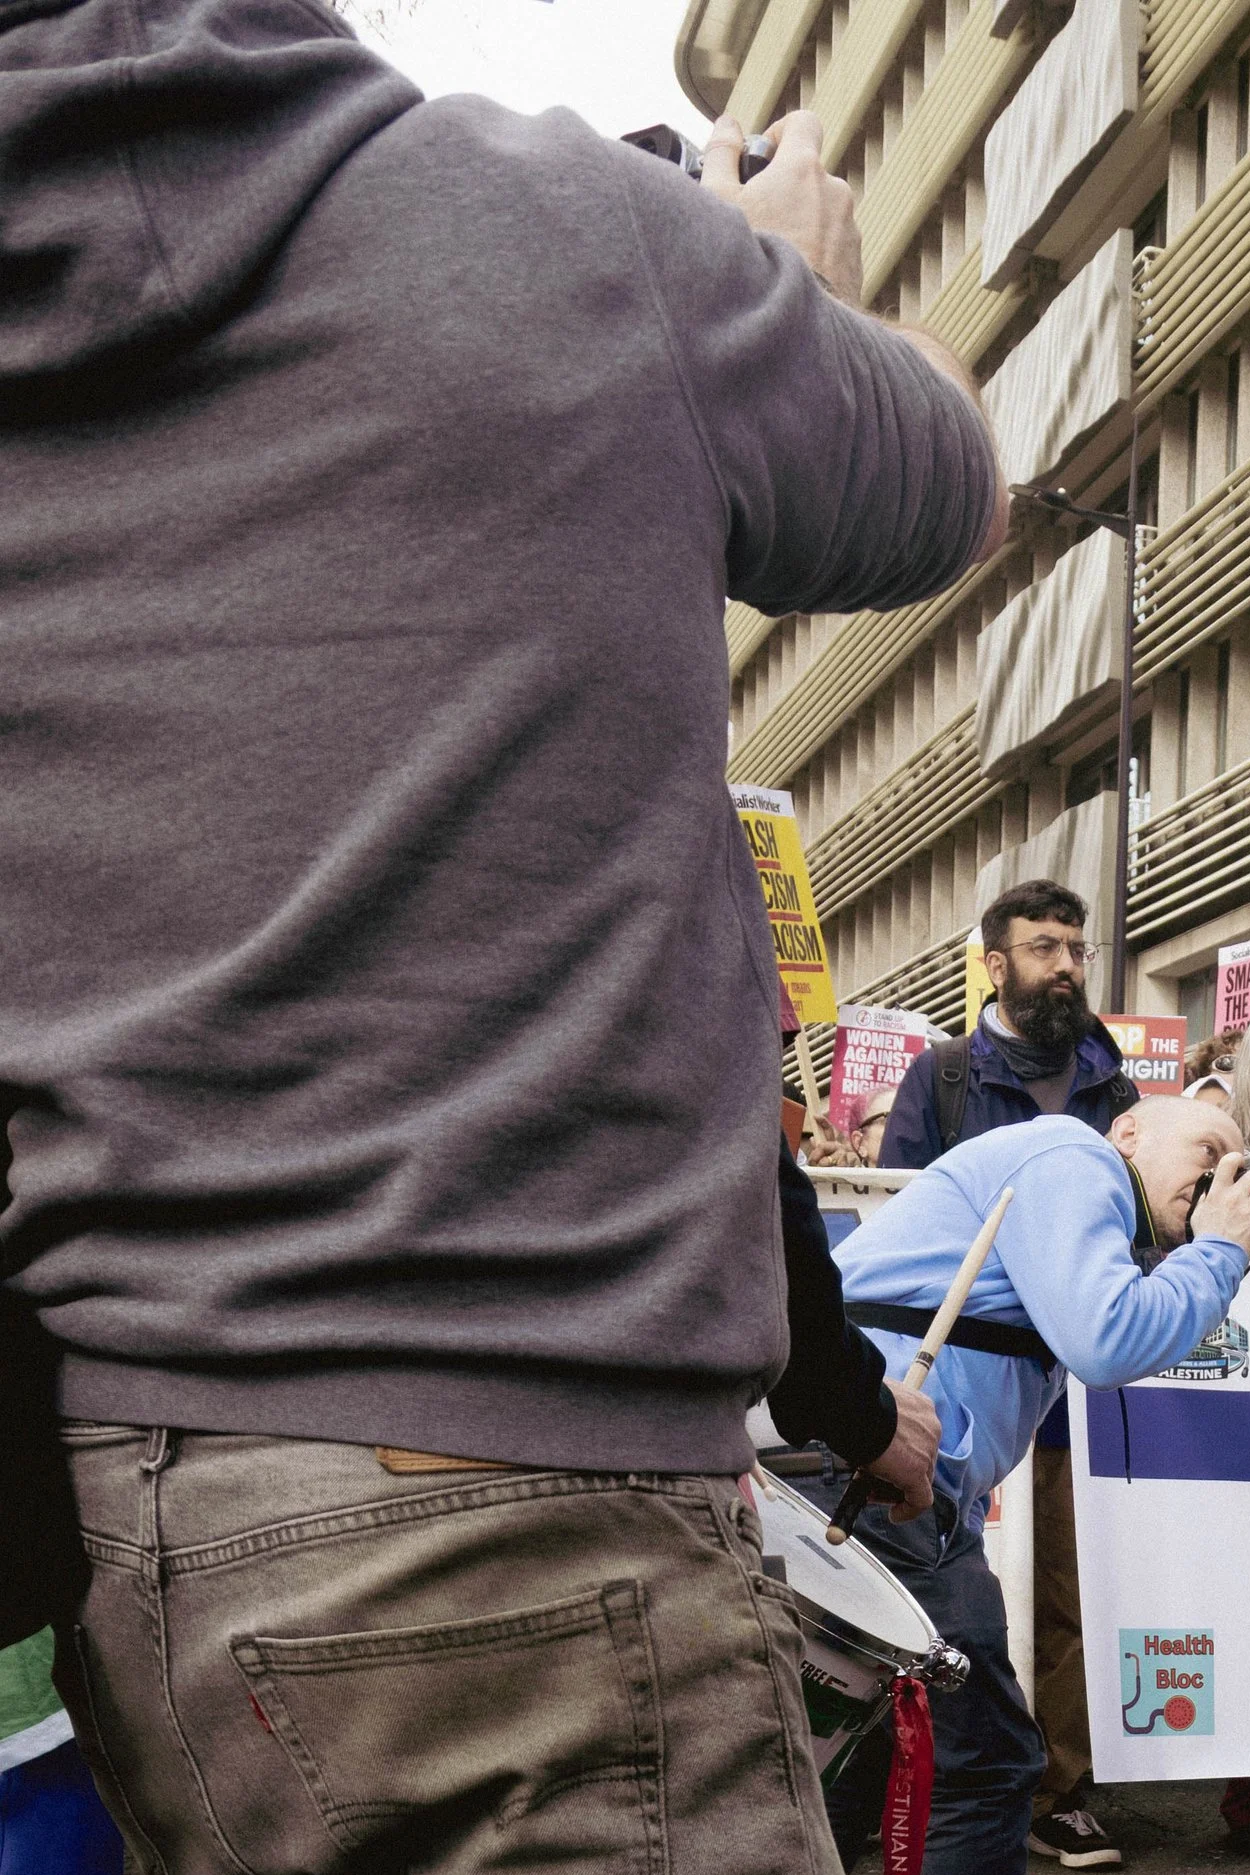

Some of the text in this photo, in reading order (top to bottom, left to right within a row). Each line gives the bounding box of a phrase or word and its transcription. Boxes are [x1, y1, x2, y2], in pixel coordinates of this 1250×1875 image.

[1224, 992, 1250, 1022] THE
[846, 1029, 905, 1051] WOMEN
[1150, 1037, 1179, 1054] THE
[843, 1046, 914, 1068] AGAINST
[843, 1062, 874, 1080] THE
[1144, 1634, 1214, 1656] Health
[1156, 1668, 1204, 1689] Bloc
